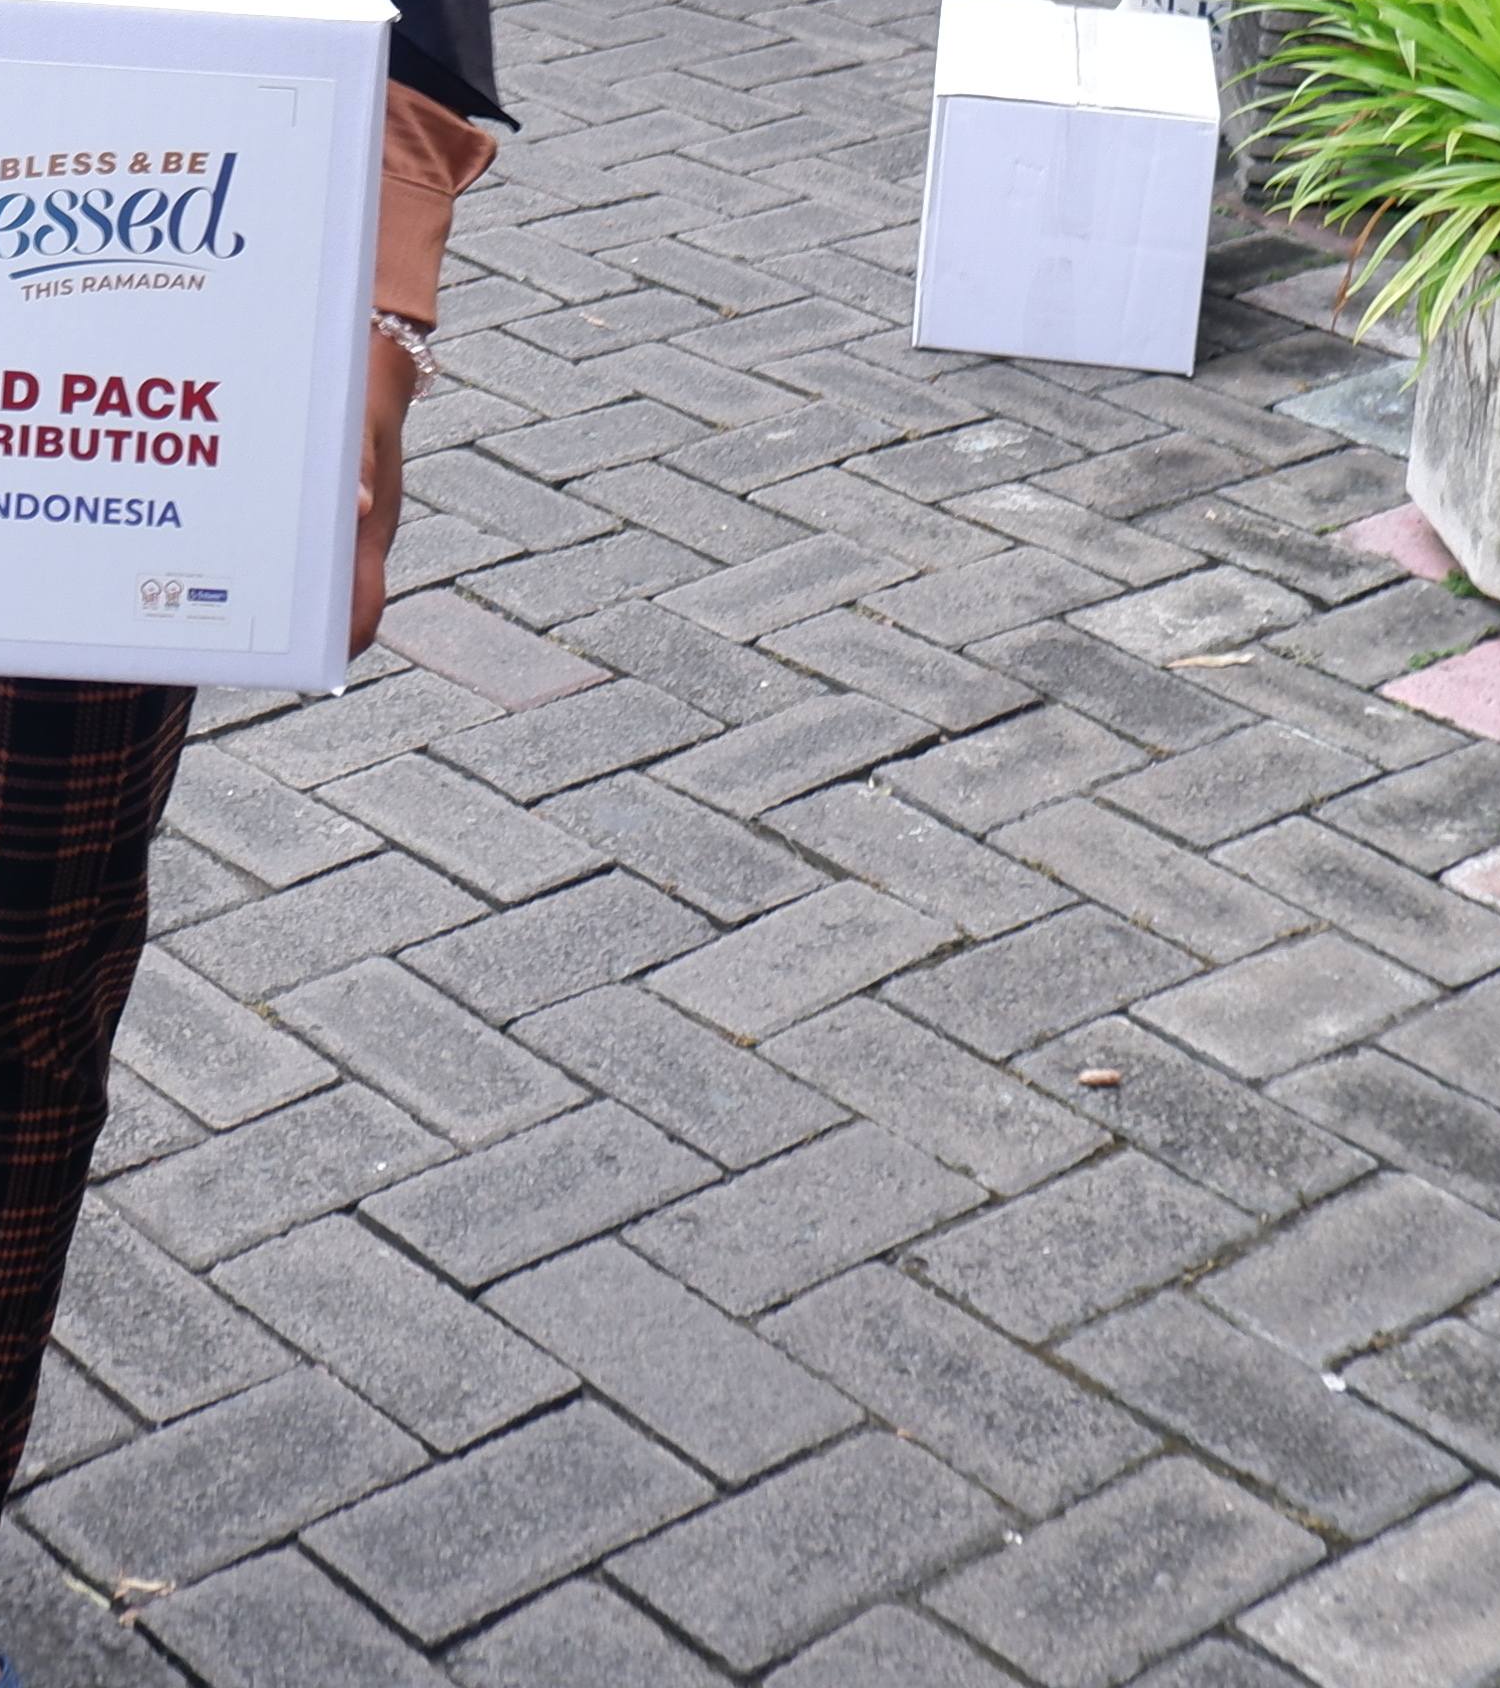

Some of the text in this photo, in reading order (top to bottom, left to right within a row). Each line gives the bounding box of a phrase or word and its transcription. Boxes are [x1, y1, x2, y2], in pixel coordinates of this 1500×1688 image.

[0, 151, 210, 181] BLESS & BE
[21, 273, 206, 302] THIS RAMADAN
[59, 373, 222, 422] PACK
